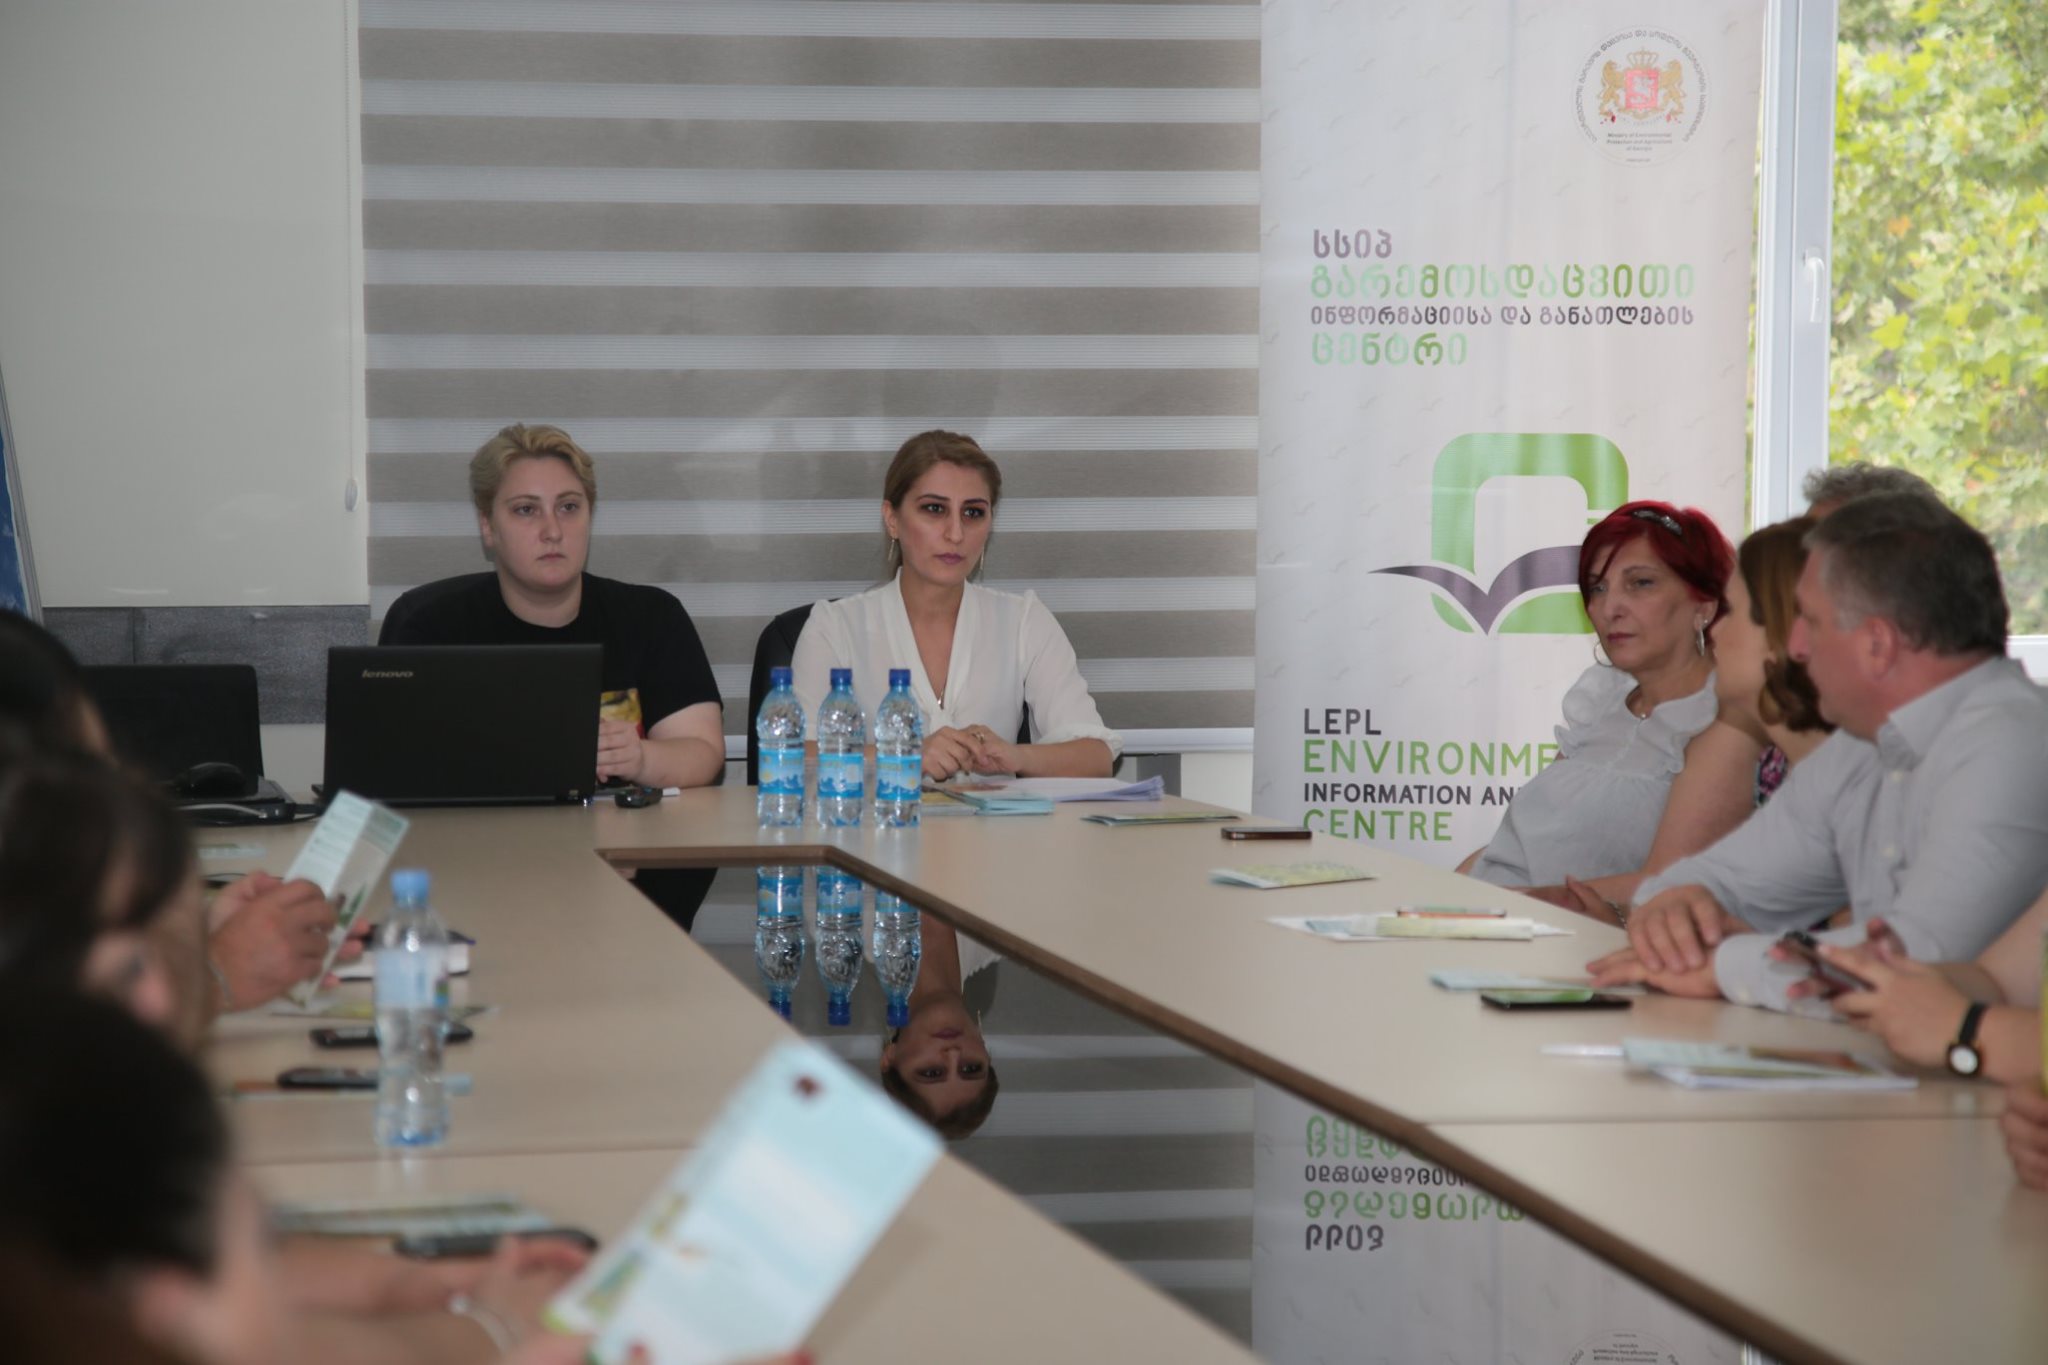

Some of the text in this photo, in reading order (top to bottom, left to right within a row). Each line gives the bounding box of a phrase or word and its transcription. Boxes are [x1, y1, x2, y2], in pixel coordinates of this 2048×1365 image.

[1313, 229, 1392, 259] სსიპ
[1310, 264, 1695, 299] გარემოსდაცვითი
[1311, 305, 1694, 326] ინფორმაციისა და განათლების
[1311, 332, 1467, 366] ცენტრი
[361, 669, 414, 679] lenovo
[1303, 708, 1382, 736] LEPL
[1303, 739, 1559, 777] ENVIRONME
[1304, 783, 1521, 806] INFORMATION AN
[1303, 809, 1454, 841] CENTRE
